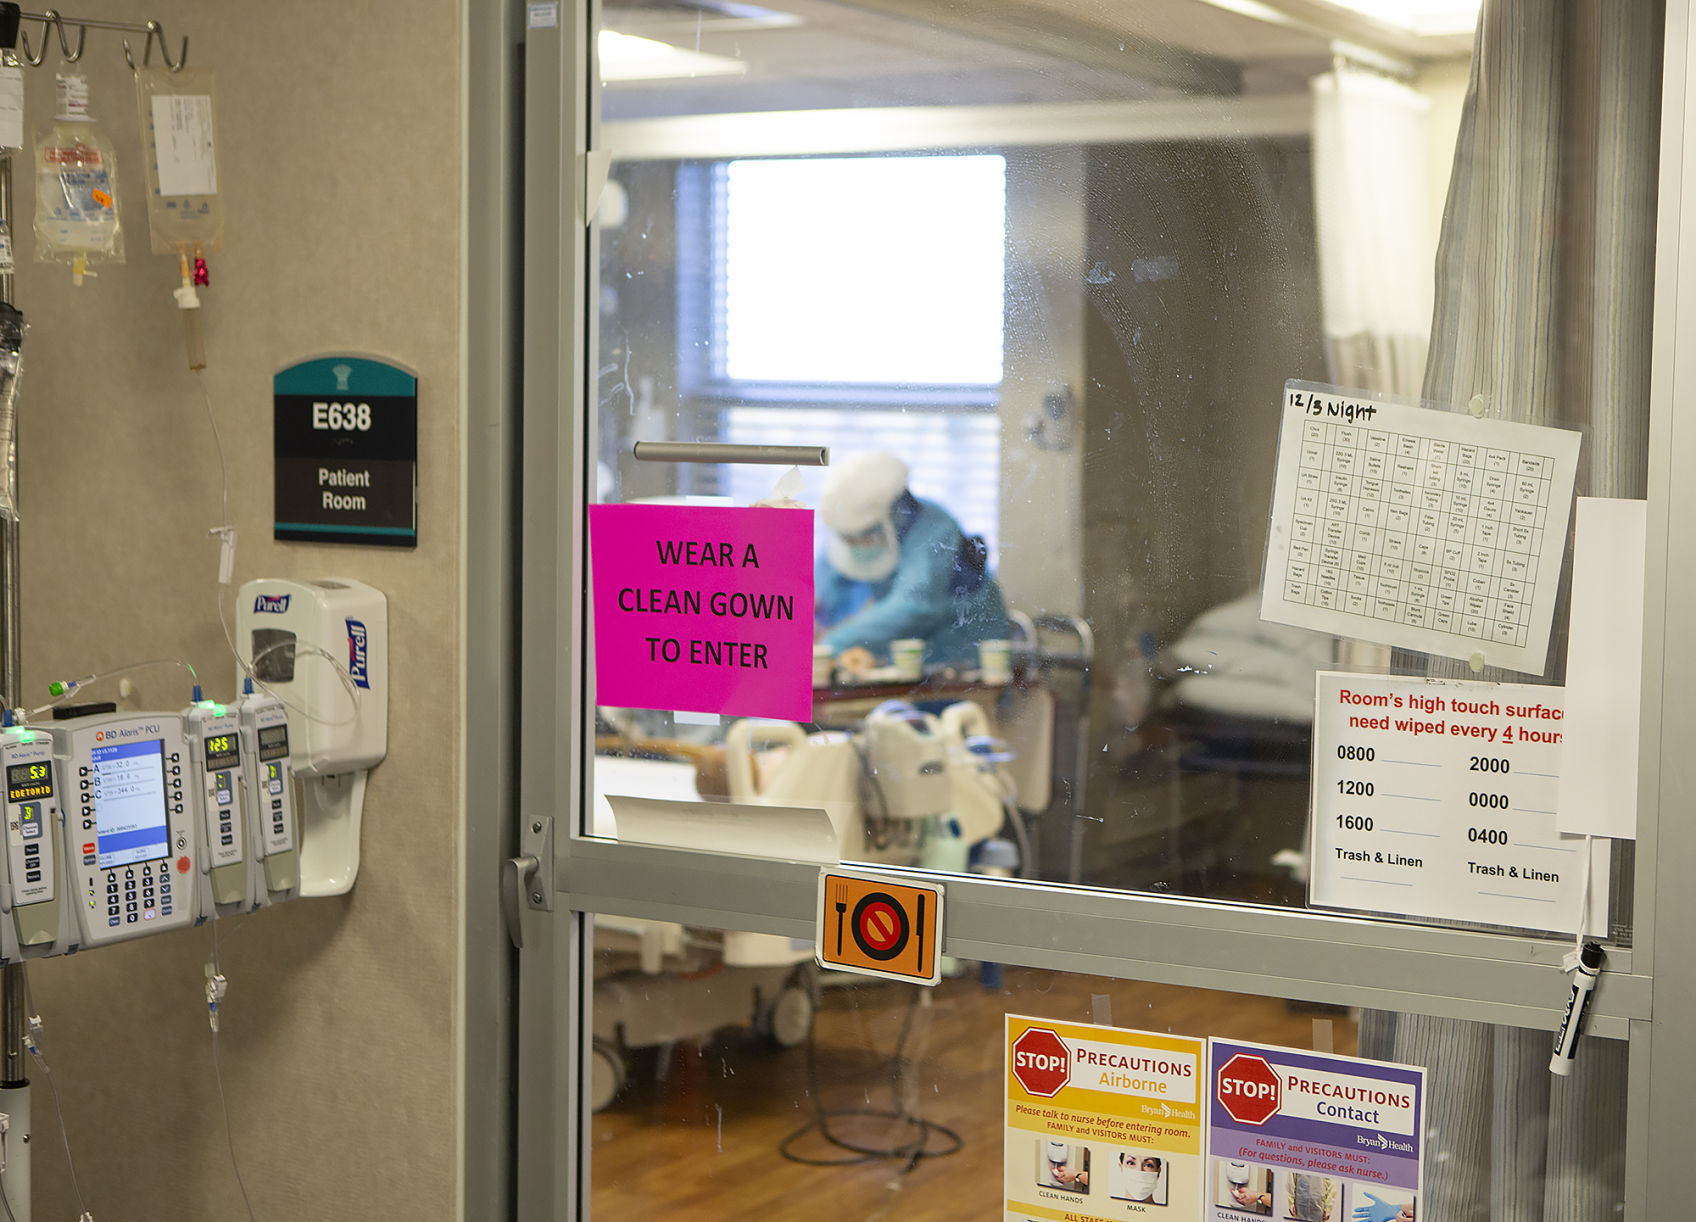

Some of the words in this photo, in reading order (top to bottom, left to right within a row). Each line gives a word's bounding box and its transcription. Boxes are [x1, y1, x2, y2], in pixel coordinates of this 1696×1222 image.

[313, 402, 371, 431] E638
[1328, 401, 1376, 424] Night
[319, 468, 370, 487] Patient
[323, 492, 365, 510] Room
[656, 540, 734, 567] WEAR
[742, 543, 759, 568] A
[257, 597, 287, 613] Purell
[618, 588, 700, 615] CLEAN
[710, 592, 793, 620] GOWN
[350, 624, 366, 683] Purell
[645, 637, 680, 662] TO
[690, 640, 768, 669] ENTER
[1339, 689, 1403, 709] Room’s
[1409, 694, 1446, 713] high
[1451, 699, 1500, 716] touch
[1506, 705, 1564, 720] surfac
[106, 731, 117, 739] BD
[145, 725, 160, 733] PCU
[1349, 715, 1389, 731] need
[1395, 718, 1445, 736] wiped
[1450, 725, 1497, 743] every
[1502, 726, 1513, 744] 4
[1337, 745, 1375, 761] 0800
[94, 764, 99, 773] A
[1469, 756, 1510, 774] 2000
[95, 777, 100, 786] B
[1337, 780, 1374, 797] 1200
[95, 790, 101, 799] C
[1468, 792, 1509, 810] 0000
[1336, 815, 1374, 831] 1600
[1468, 828, 1508, 845] 0400
[1335, 848, 1370, 862] Trash
[1374, 851, 1384, 864] &
[1387, 853, 1423, 868] Linen
[1468, 862, 1504, 877] Trash
[1509, 866, 1518, 878] &
[1523, 868, 1559, 883] Linen
[1016, 1051, 1065, 1073] STOP!
[1077, 1048, 1192, 1077] PRECAUTIONS
[1099, 1072, 1167, 1093] Airborne
[1222, 1078, 1275, 1101] STOP!
[1288, 1076, 1410, 1109] PRECAUTIONS
[1016, 1104, 1040, 1116] Please
[1042, 1109, 1059, 1119] talk
[1060, 1113, 1069, 1121] to
[1071, 1116, 1094, 1124] nurse
[1097, 1117, 1123, 1129] before
[1125, 1121, 1162, 1136] entering
[1164, 1128, 1191, 1138] room.
[1141, 1104, 1164, 1117] Bryan
[1171, 1108, 1195, 1119] Health
[1317, 1101, 1380, 1124] Contact
[1047, 1122, 1074, 1133] FAMILY
[1076, 1126, 1090, 1135] and
[1092, 1128, 1126, 1140] VISITORS
[1130, 1134, 1154, 1144] MUST:
[1256, 1139, 1286, 1150] FAMILY
[1288, 1144, 1303, 1153] and
[1305, 1146, 1342, 1159] VISITORS
[1345, 1153, 1370, 1165] MUST:
[1357, 1135, 1380, 1148] Bryan
[1388, 1141, 1413, 1153] Health
[1239, 1147, 1257, 1158] (For
[1259, 1151, 1305, 1168] questions,
[1307, 1158, 1337, 1172] please
[1339, 1164, 1354, 1174] ask
[1357, 1168, 1388, 1181] nurse.)
[1039, 1191, 1058, 1199] CLEAN
[1061, 1195, 1083, 1204] HANDS
[1127, 1204, 1146, 1213] MASK
[1217, 1212, 1239, 1221] CLEAN
